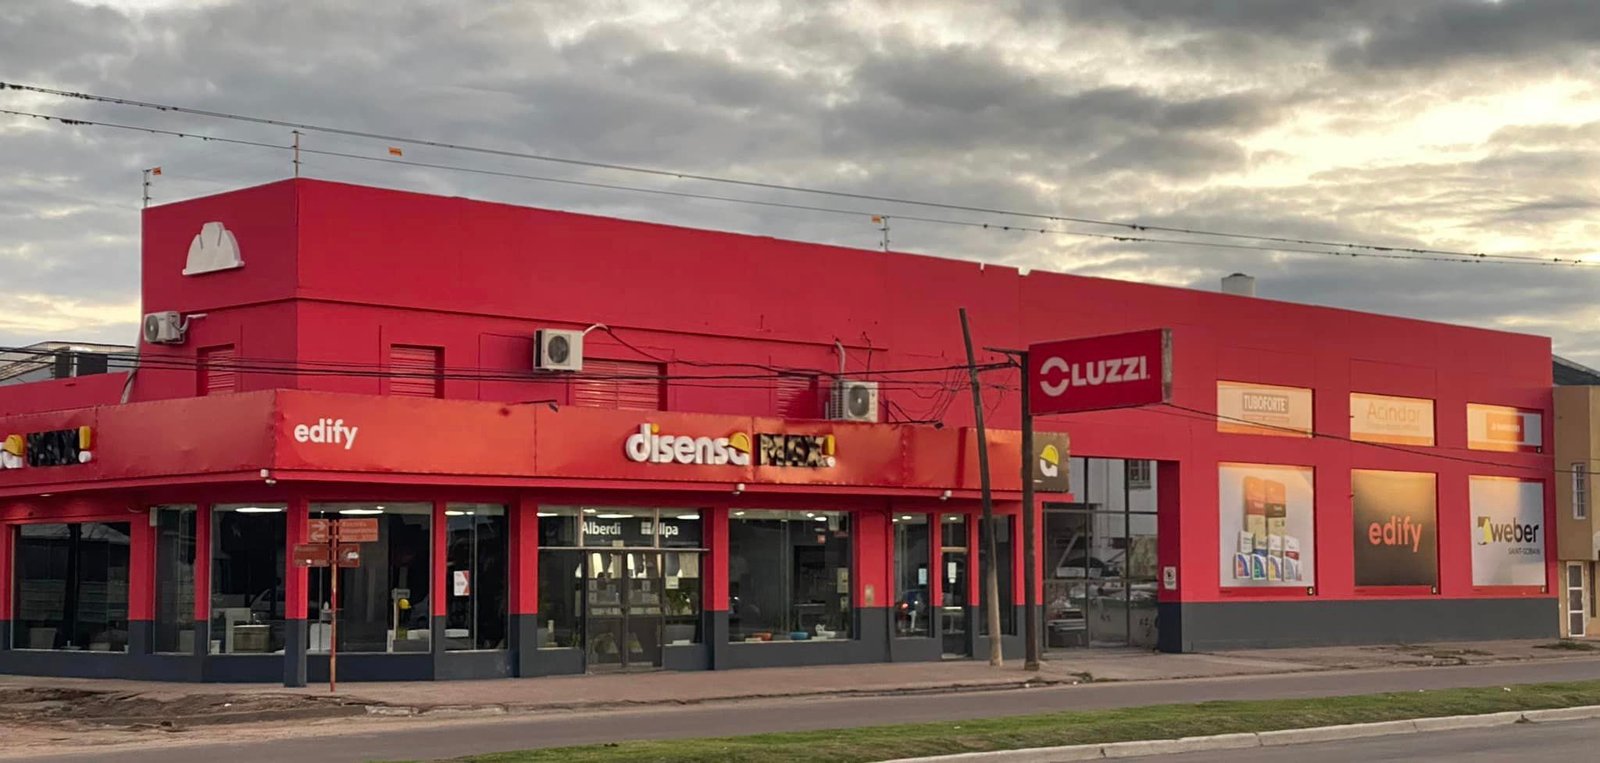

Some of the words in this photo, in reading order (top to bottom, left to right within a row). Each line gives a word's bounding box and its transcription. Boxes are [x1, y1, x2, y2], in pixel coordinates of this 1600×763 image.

[1072, 356, 1146, 386] LUZZI
[294, 418, 358, 450] edify
[626, 423, 749, 465] disensa
[582, 521, 621, 535] Alberdi
[1369, 515, 1422, 553] edify
[1489, 517, 1539, 543] weber
